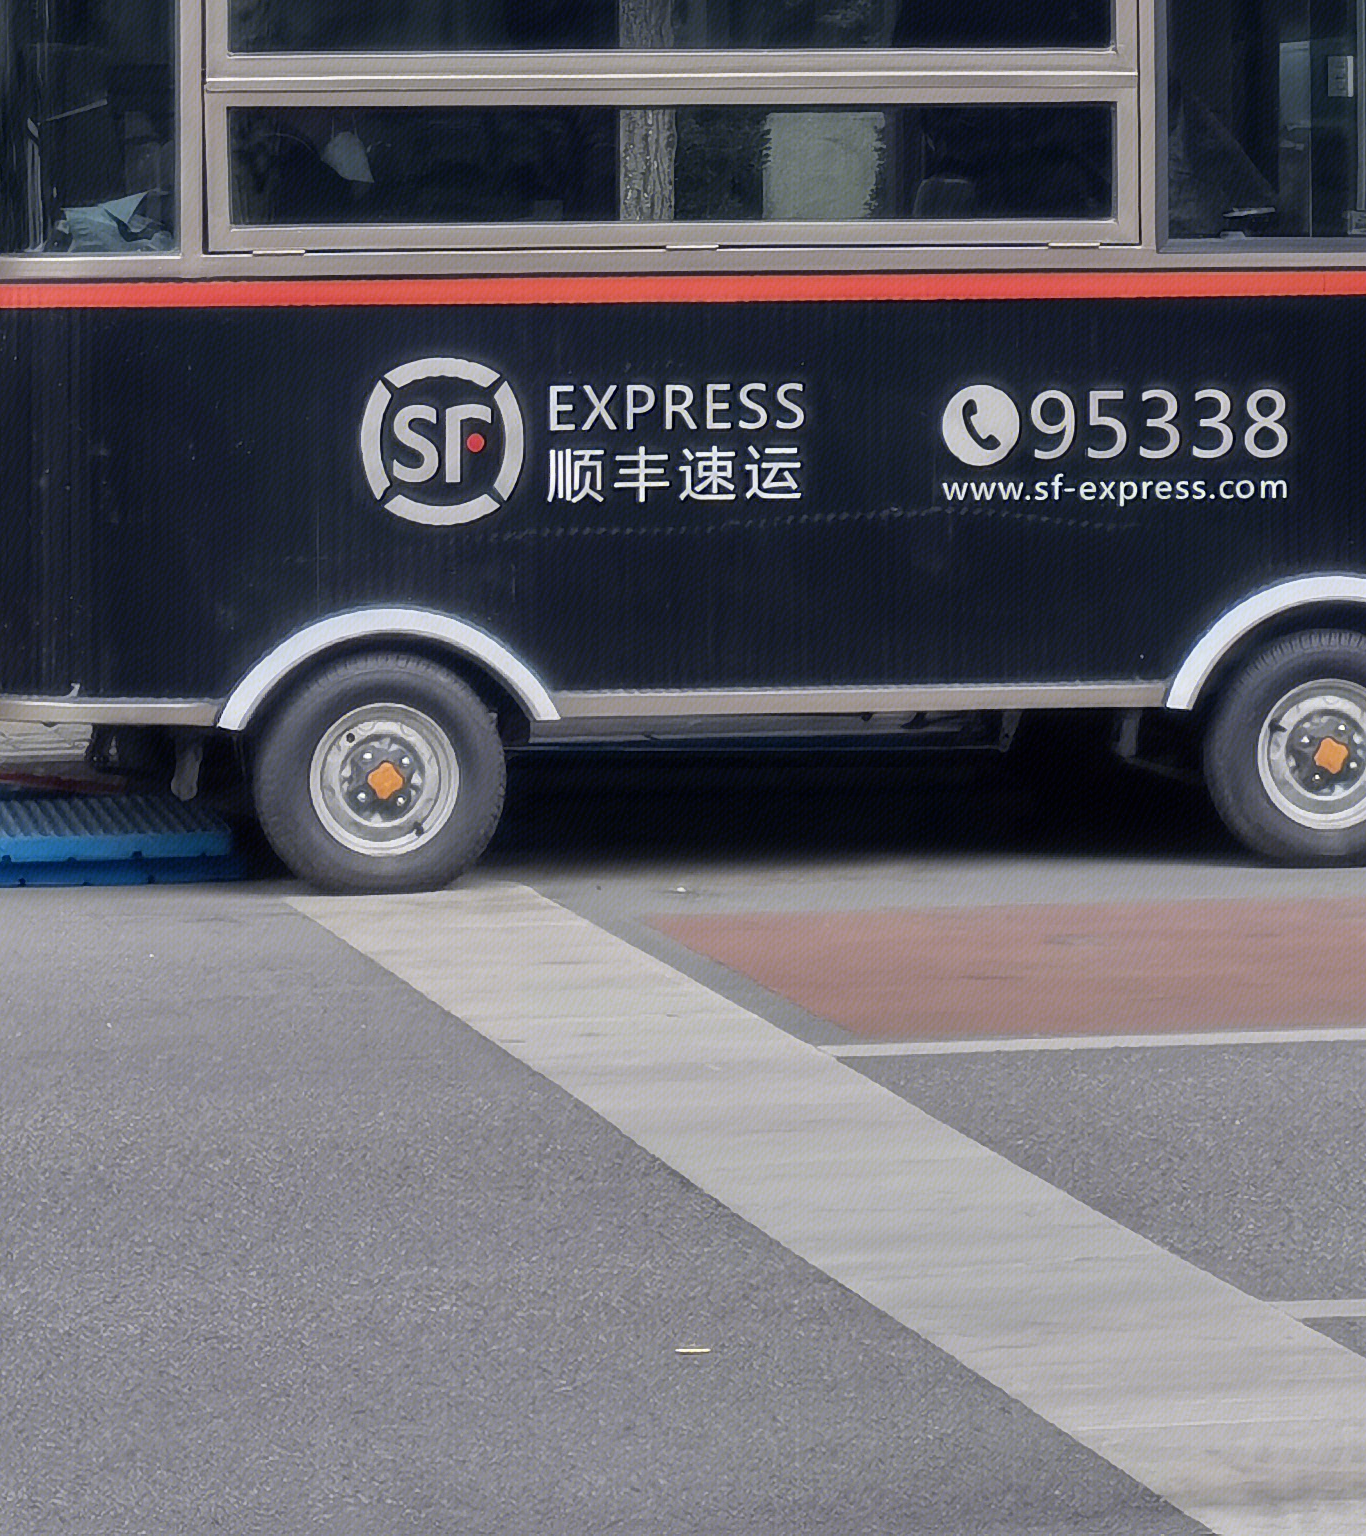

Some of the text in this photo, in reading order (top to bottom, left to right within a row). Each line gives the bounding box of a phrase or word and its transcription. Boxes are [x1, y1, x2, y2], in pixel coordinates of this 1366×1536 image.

[548, 382, 806, 433] EXPRESS
[1030, 388, 1289, 460] 95338
[545, 446, 802, 504] 顺丰速运
[941, 472, 1289, 507] www.sf-express.com
